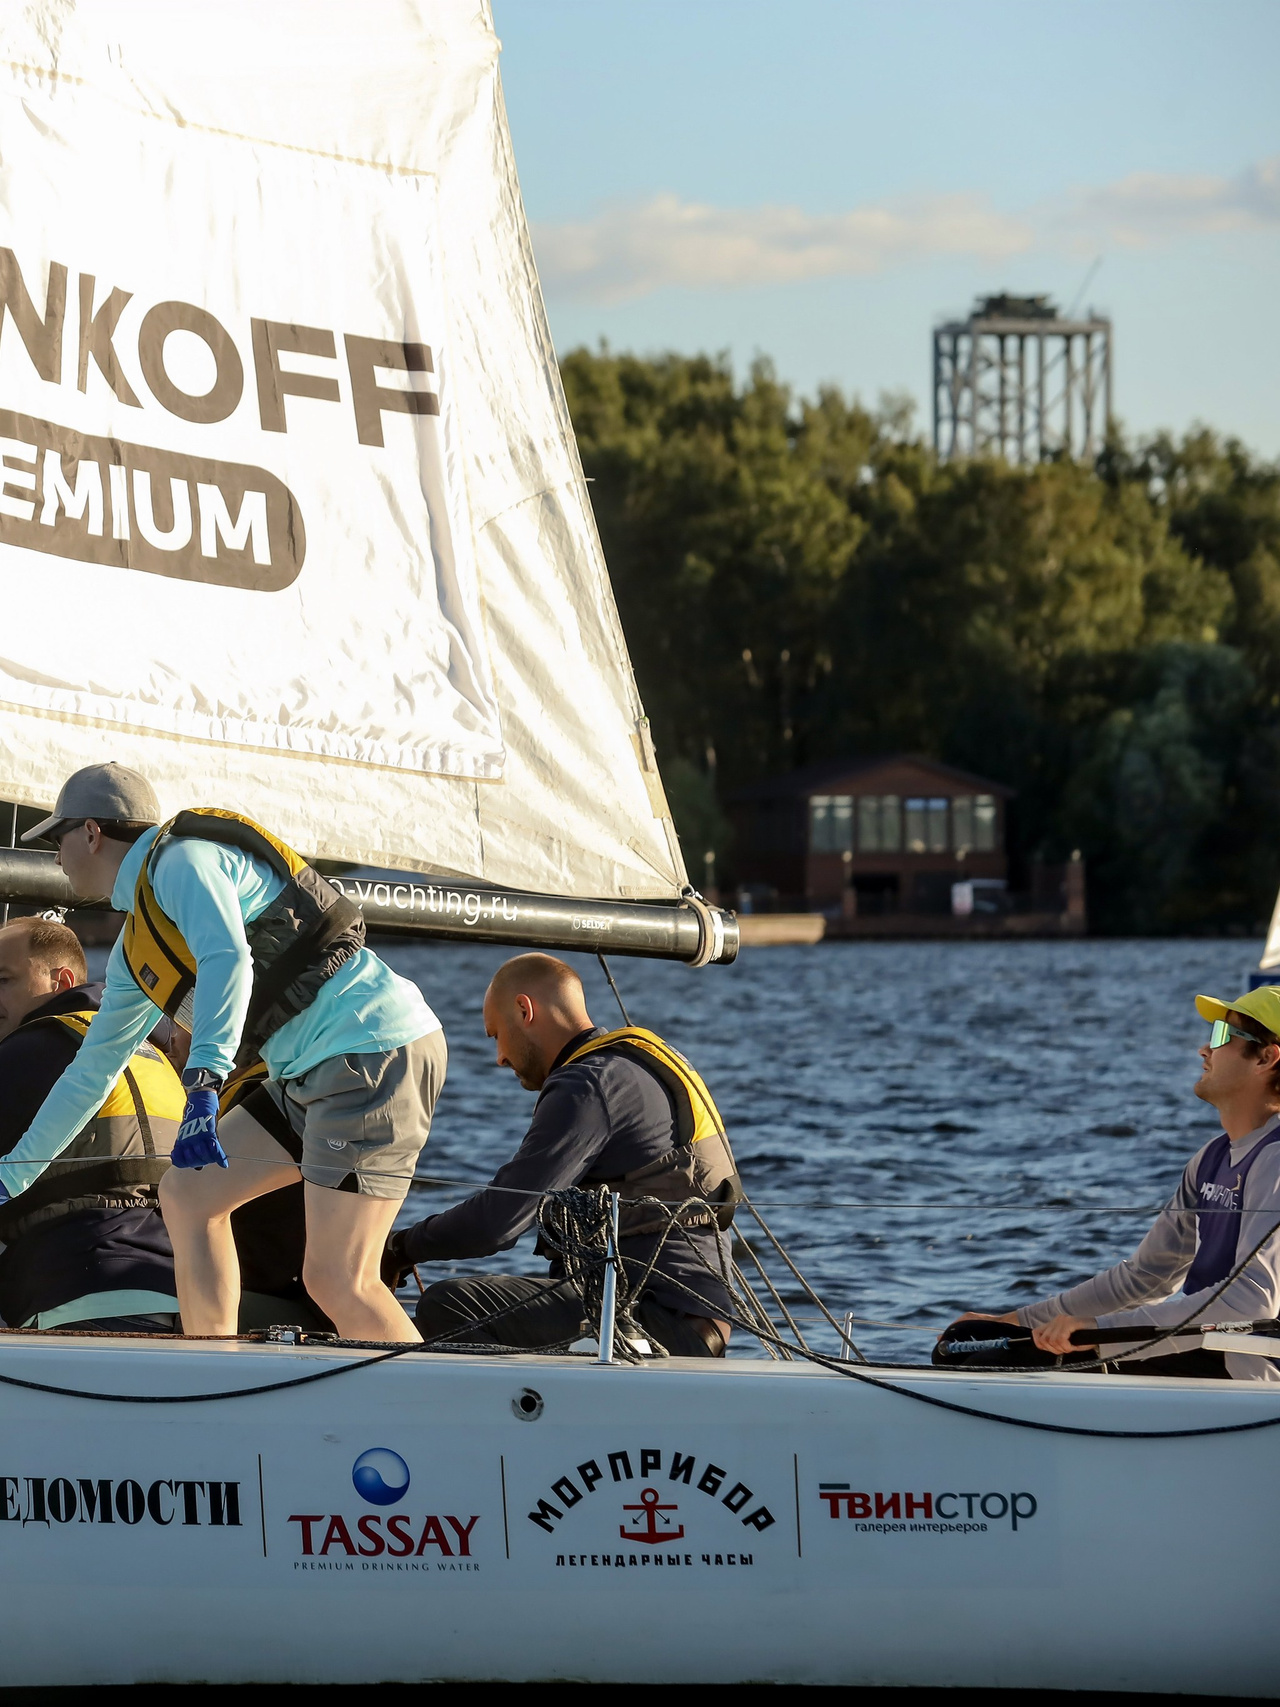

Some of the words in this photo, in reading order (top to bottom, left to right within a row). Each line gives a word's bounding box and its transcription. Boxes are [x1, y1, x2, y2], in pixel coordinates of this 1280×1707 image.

[178, 1115, 213, 1140] FOX
[527, 1448, 776, 1534] МОРПРИБОР
[286, 1514, 481, 1557] TASSAY
[855, 1522, 907, 1535] галерея
[909, 1522, 988, 1535] интерьеров
[293, 1561, 355, 1571] PREMIUM
[361, 1562, 430, 1571] DRINKING
[437, 1562, 481, 1572] WATER
[555, 1553, 693, 1568] ЛЕГЕНДАРНЫЕ
[701, 1553, 754, 1566] ЧАСЫ
